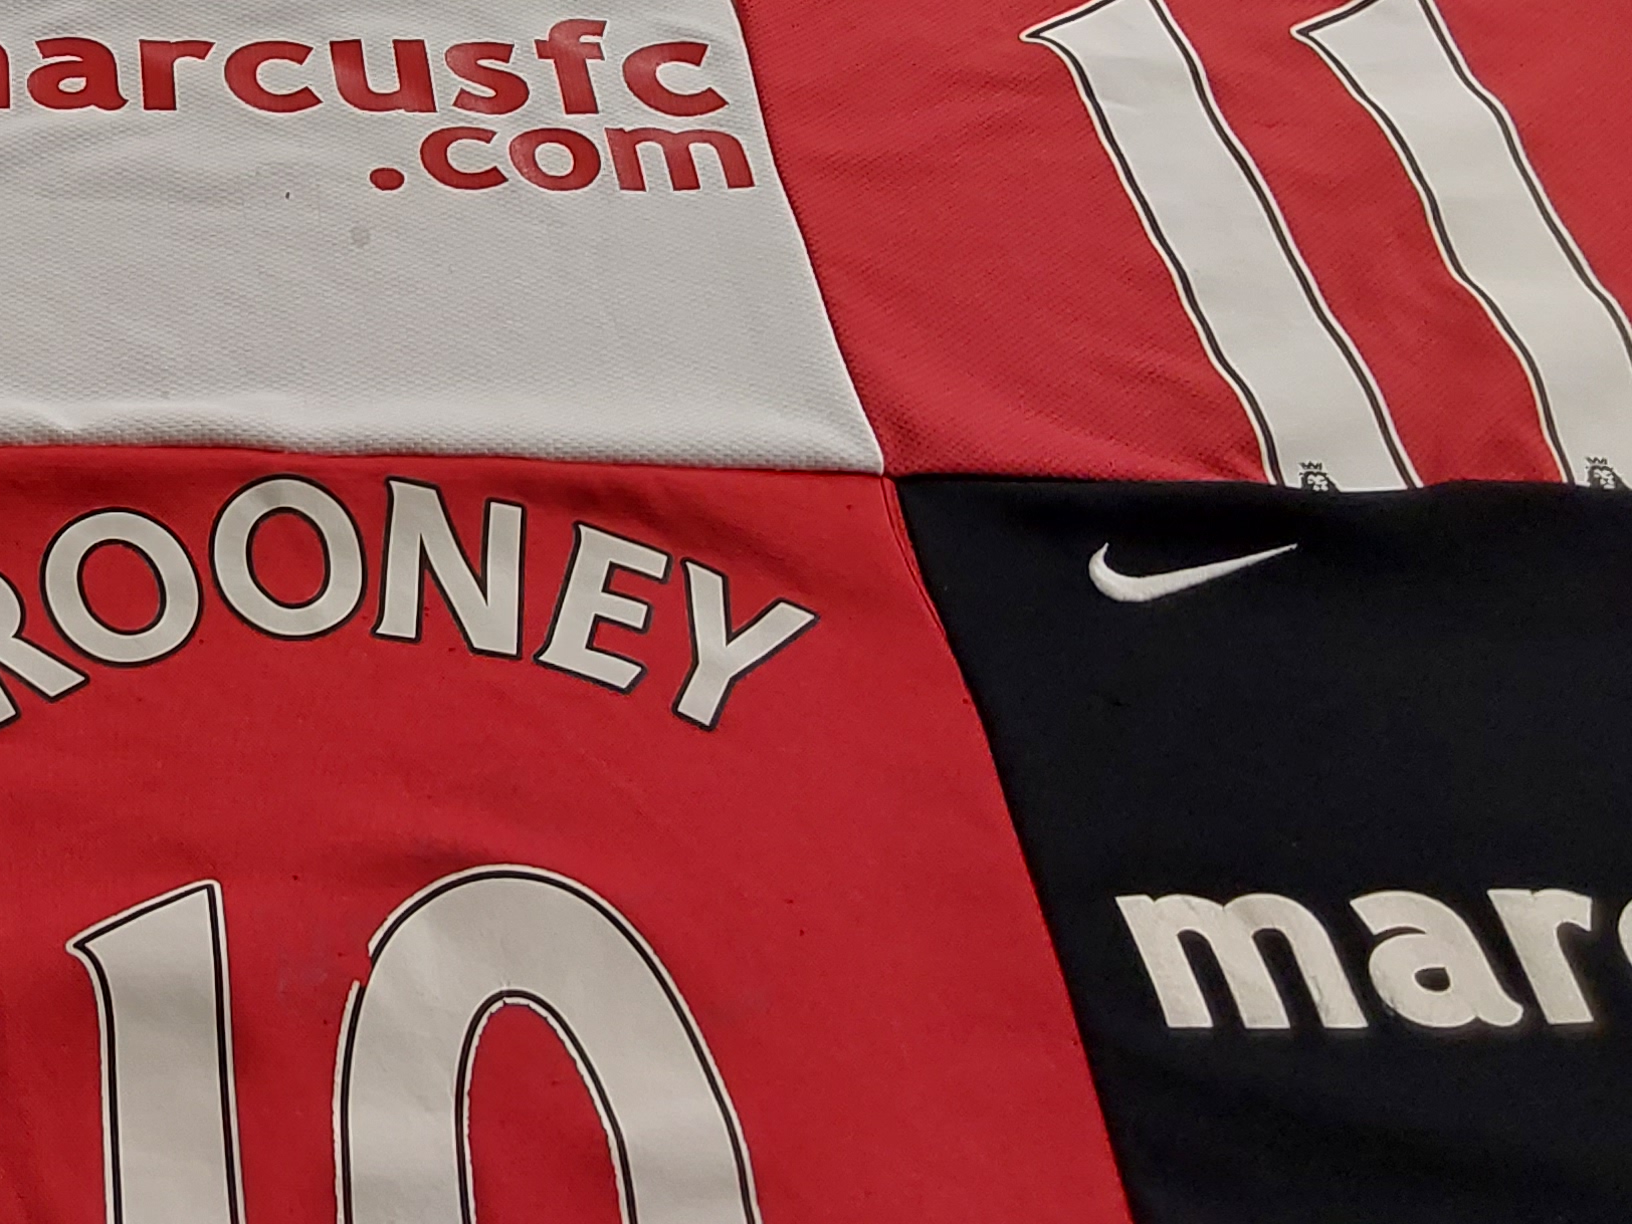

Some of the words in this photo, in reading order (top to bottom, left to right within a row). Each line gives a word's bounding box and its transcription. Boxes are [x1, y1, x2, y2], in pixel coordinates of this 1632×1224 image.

[368, 126, 756, 193] .com
[1115, 888, 1632, 1029] mar
[66, 864, 762, 1224] 10
